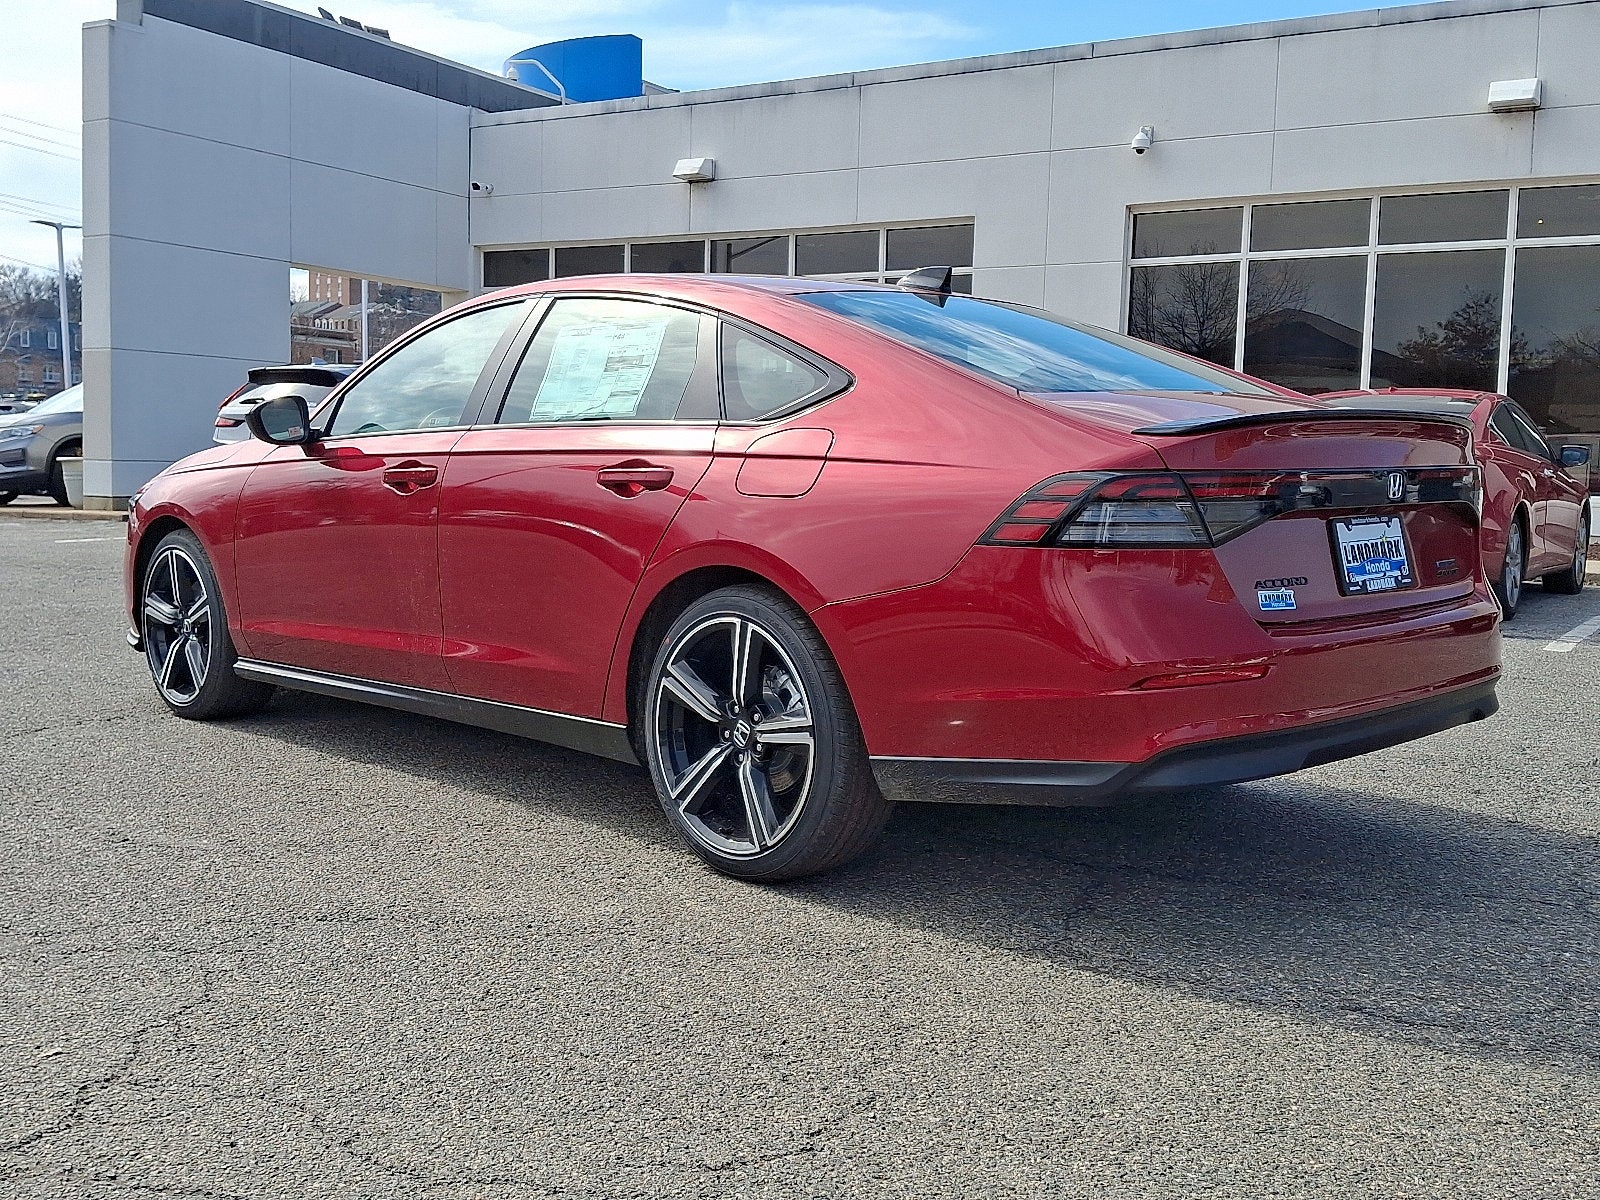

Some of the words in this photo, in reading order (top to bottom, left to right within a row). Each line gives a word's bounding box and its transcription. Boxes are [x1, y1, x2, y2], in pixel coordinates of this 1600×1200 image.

[1343, 540, 1402, 564] LANDMARK
[1365, 560, 1391, 574] Honda
[1254, 576, 1309, 589] ACCORD
[1366, 577, 1396, 591] LANDMARK
[1260, 593, 1293, 603] LANDMARK
